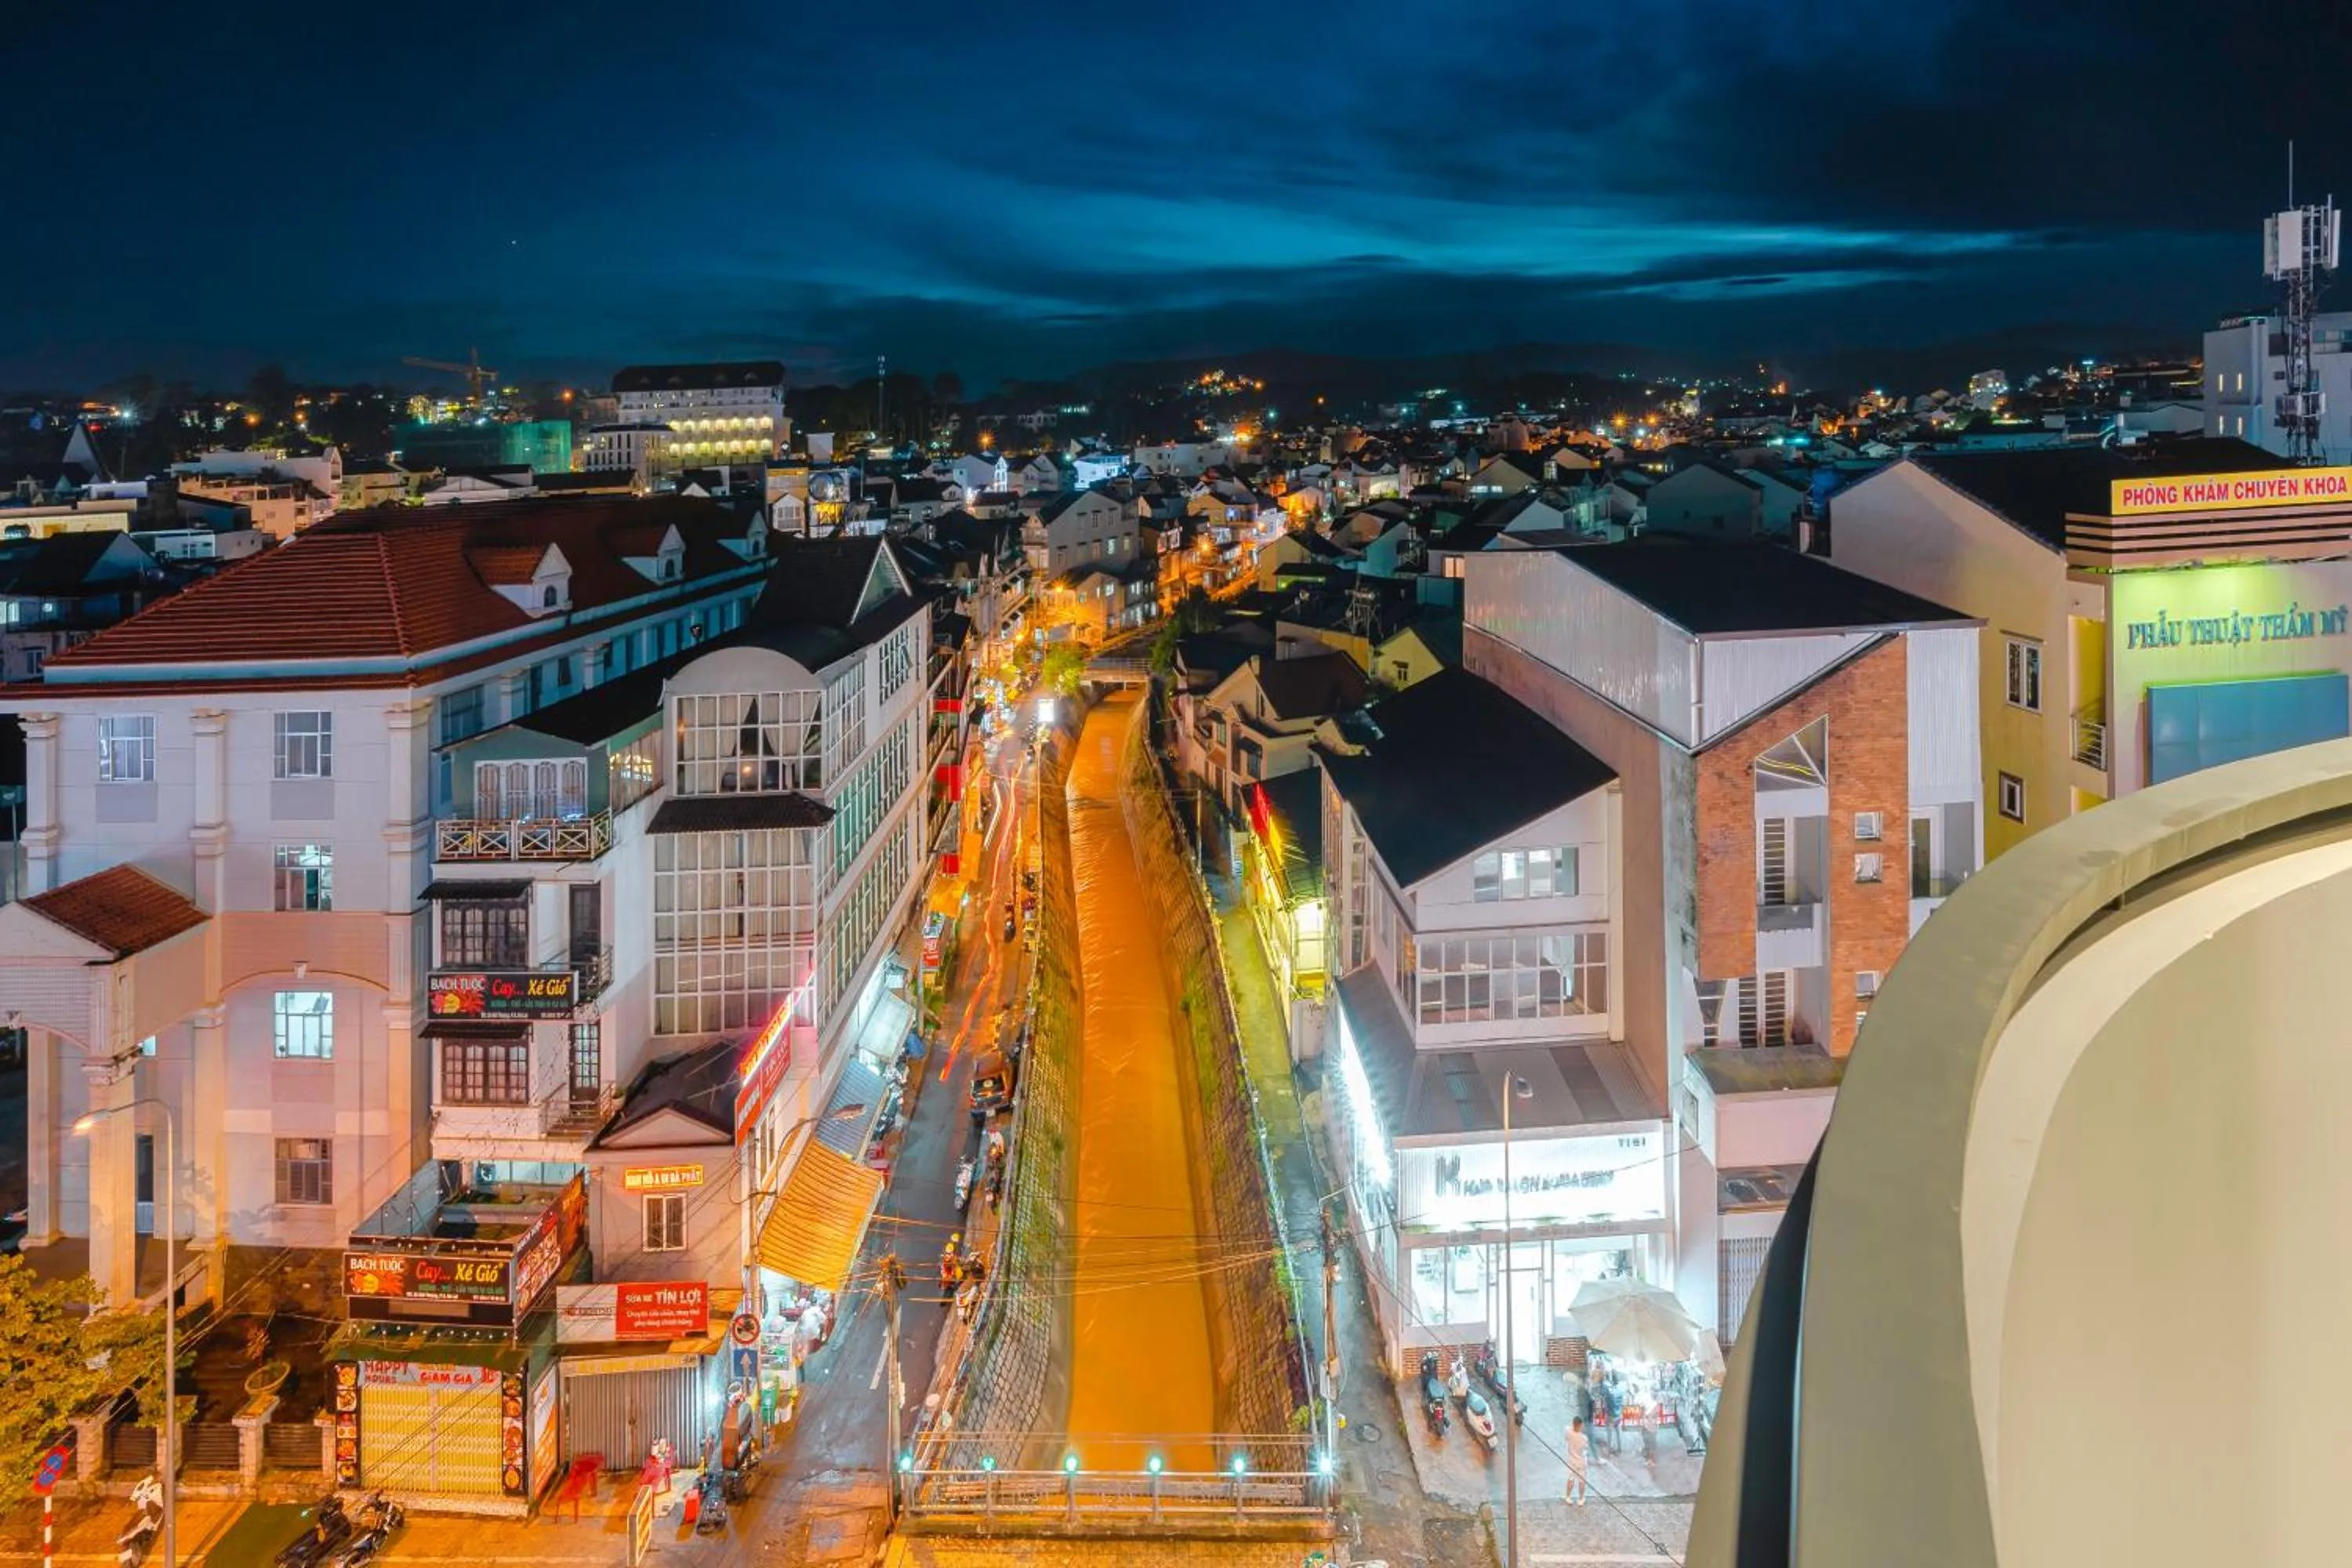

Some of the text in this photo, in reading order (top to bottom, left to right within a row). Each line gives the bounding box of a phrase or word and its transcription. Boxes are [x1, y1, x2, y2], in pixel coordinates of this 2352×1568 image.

[2122, 476, 2347, 506] PHÒNG KHÁM CHUYÊN KHOA
[2187, 610, 2253, 648] THUẬT
[365, 1361, 408, 1375] HAPPY
